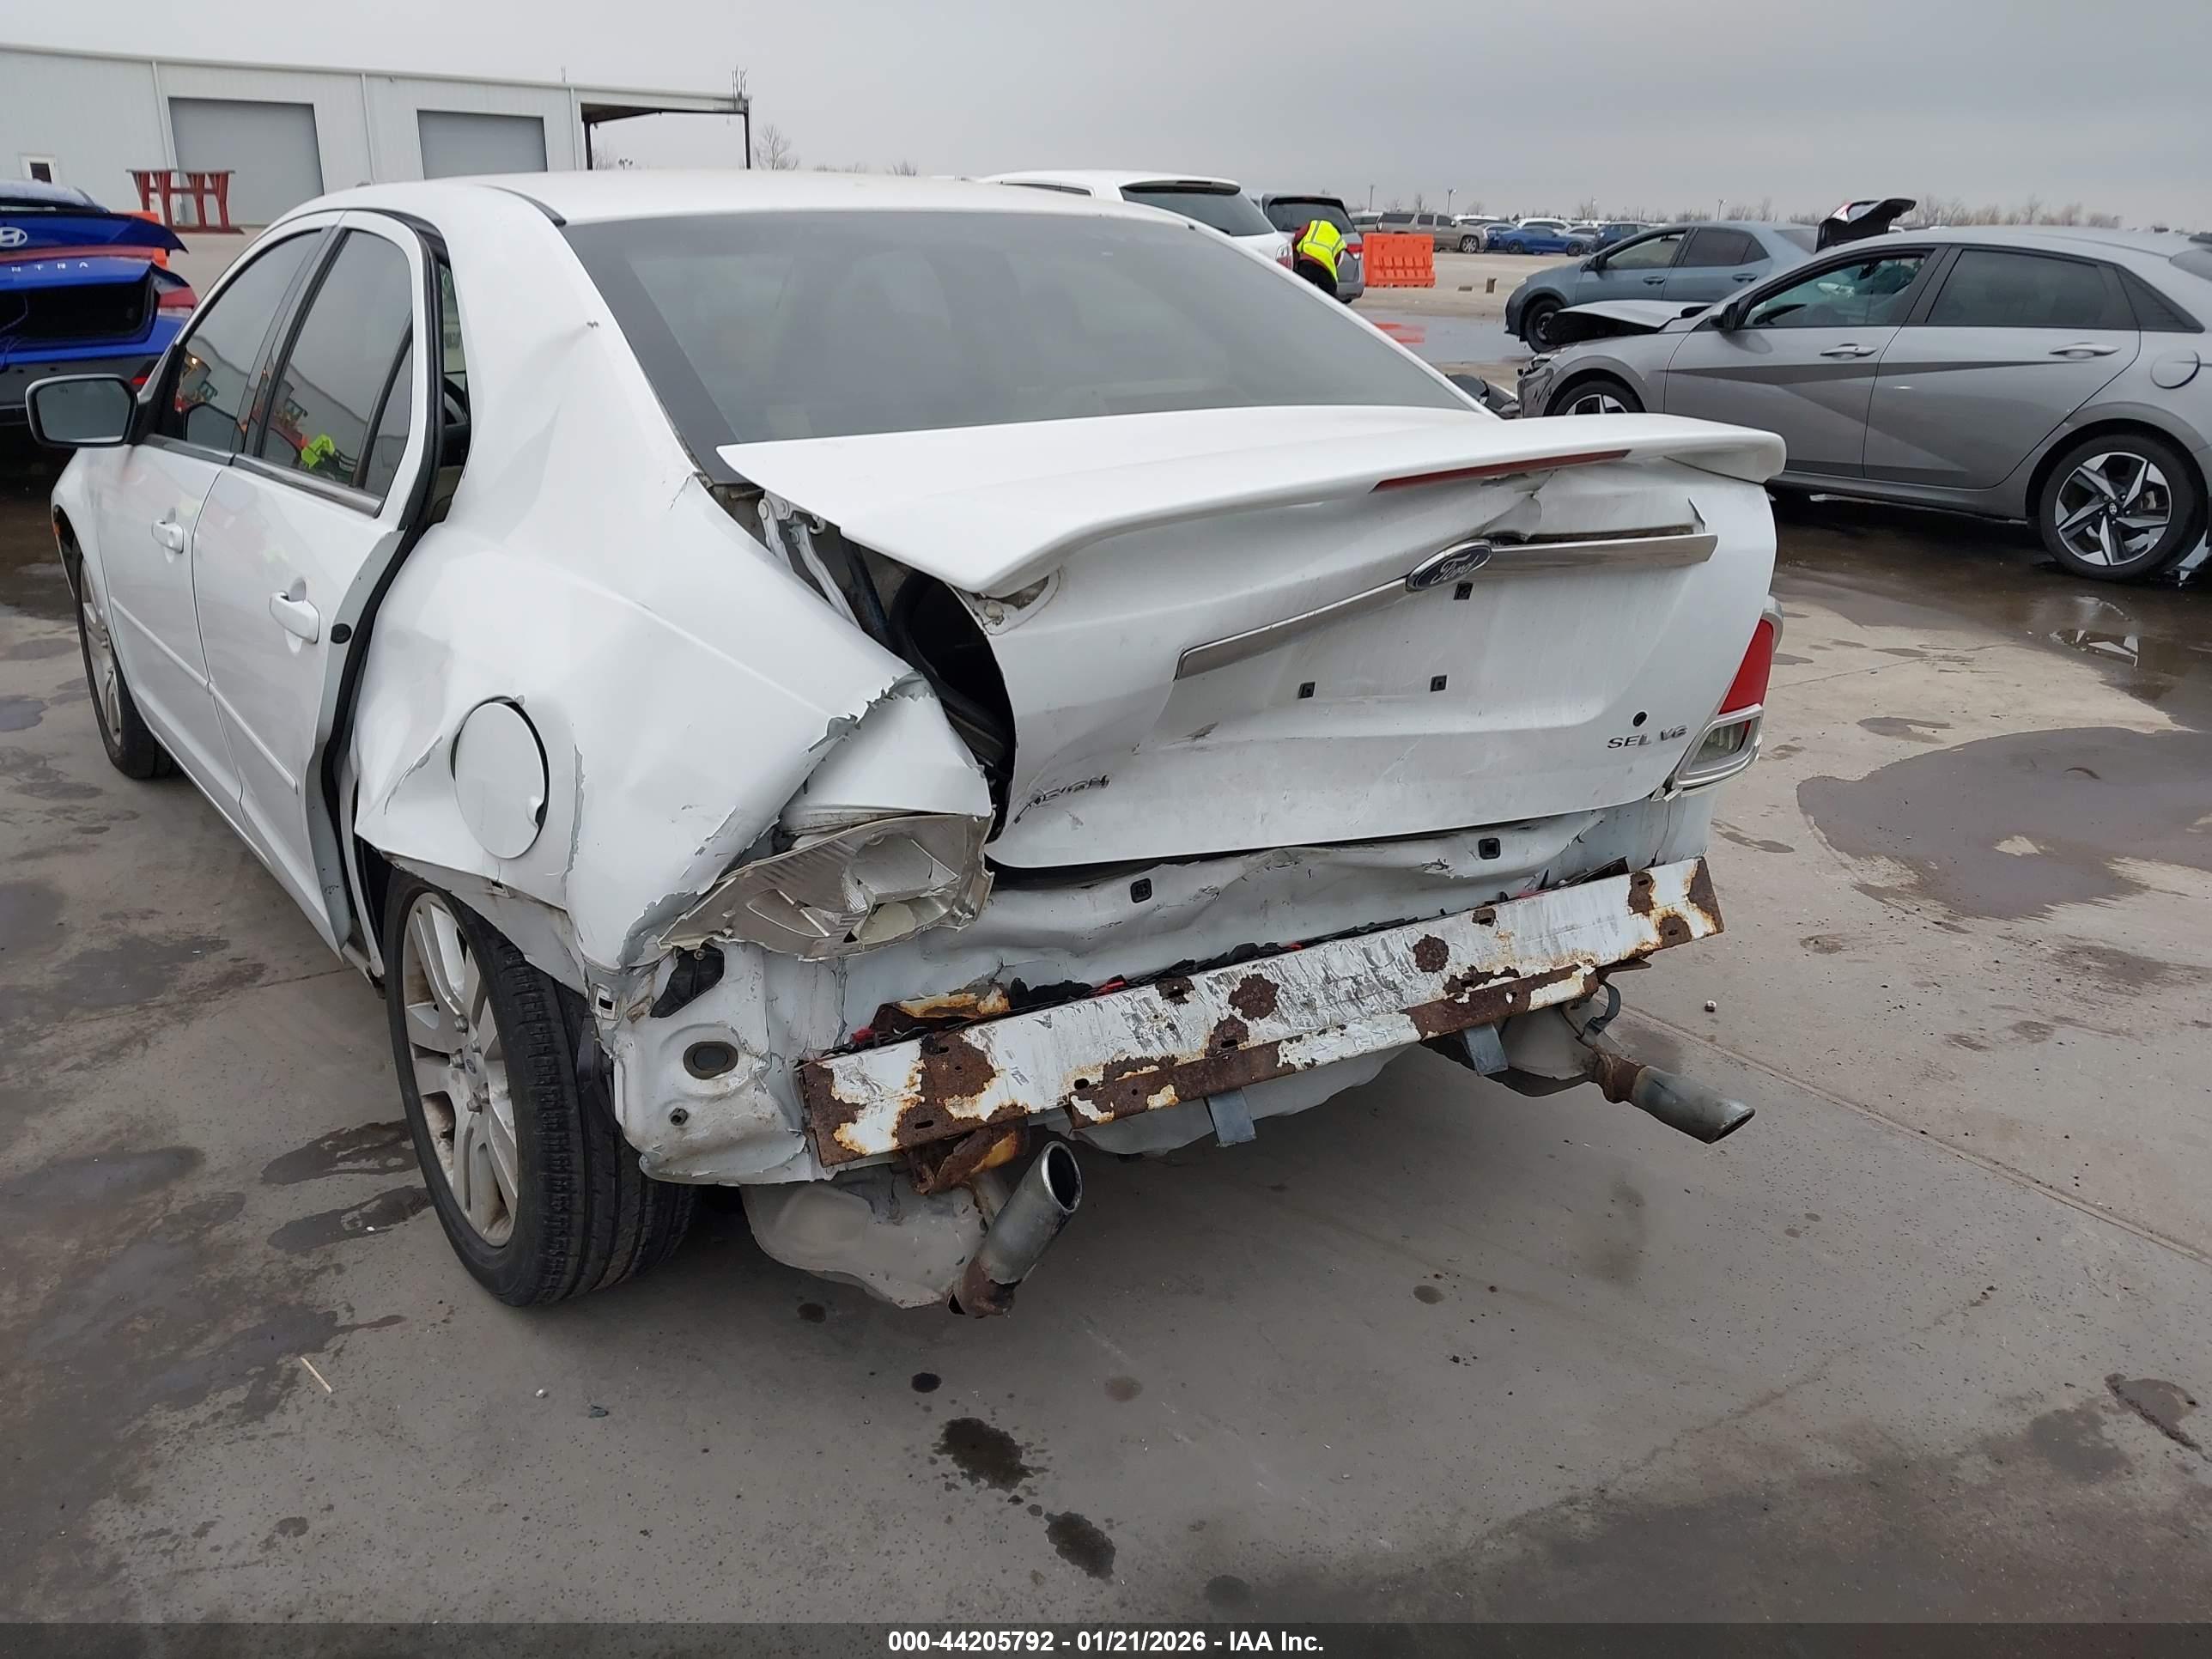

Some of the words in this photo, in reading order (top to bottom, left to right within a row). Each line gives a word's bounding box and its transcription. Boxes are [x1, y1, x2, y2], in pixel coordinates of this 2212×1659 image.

[1429, 552, 1479, 585] Ford
[1607, 733, 1652, 749] SEL
[1660, 726, 1688, 742] V6
